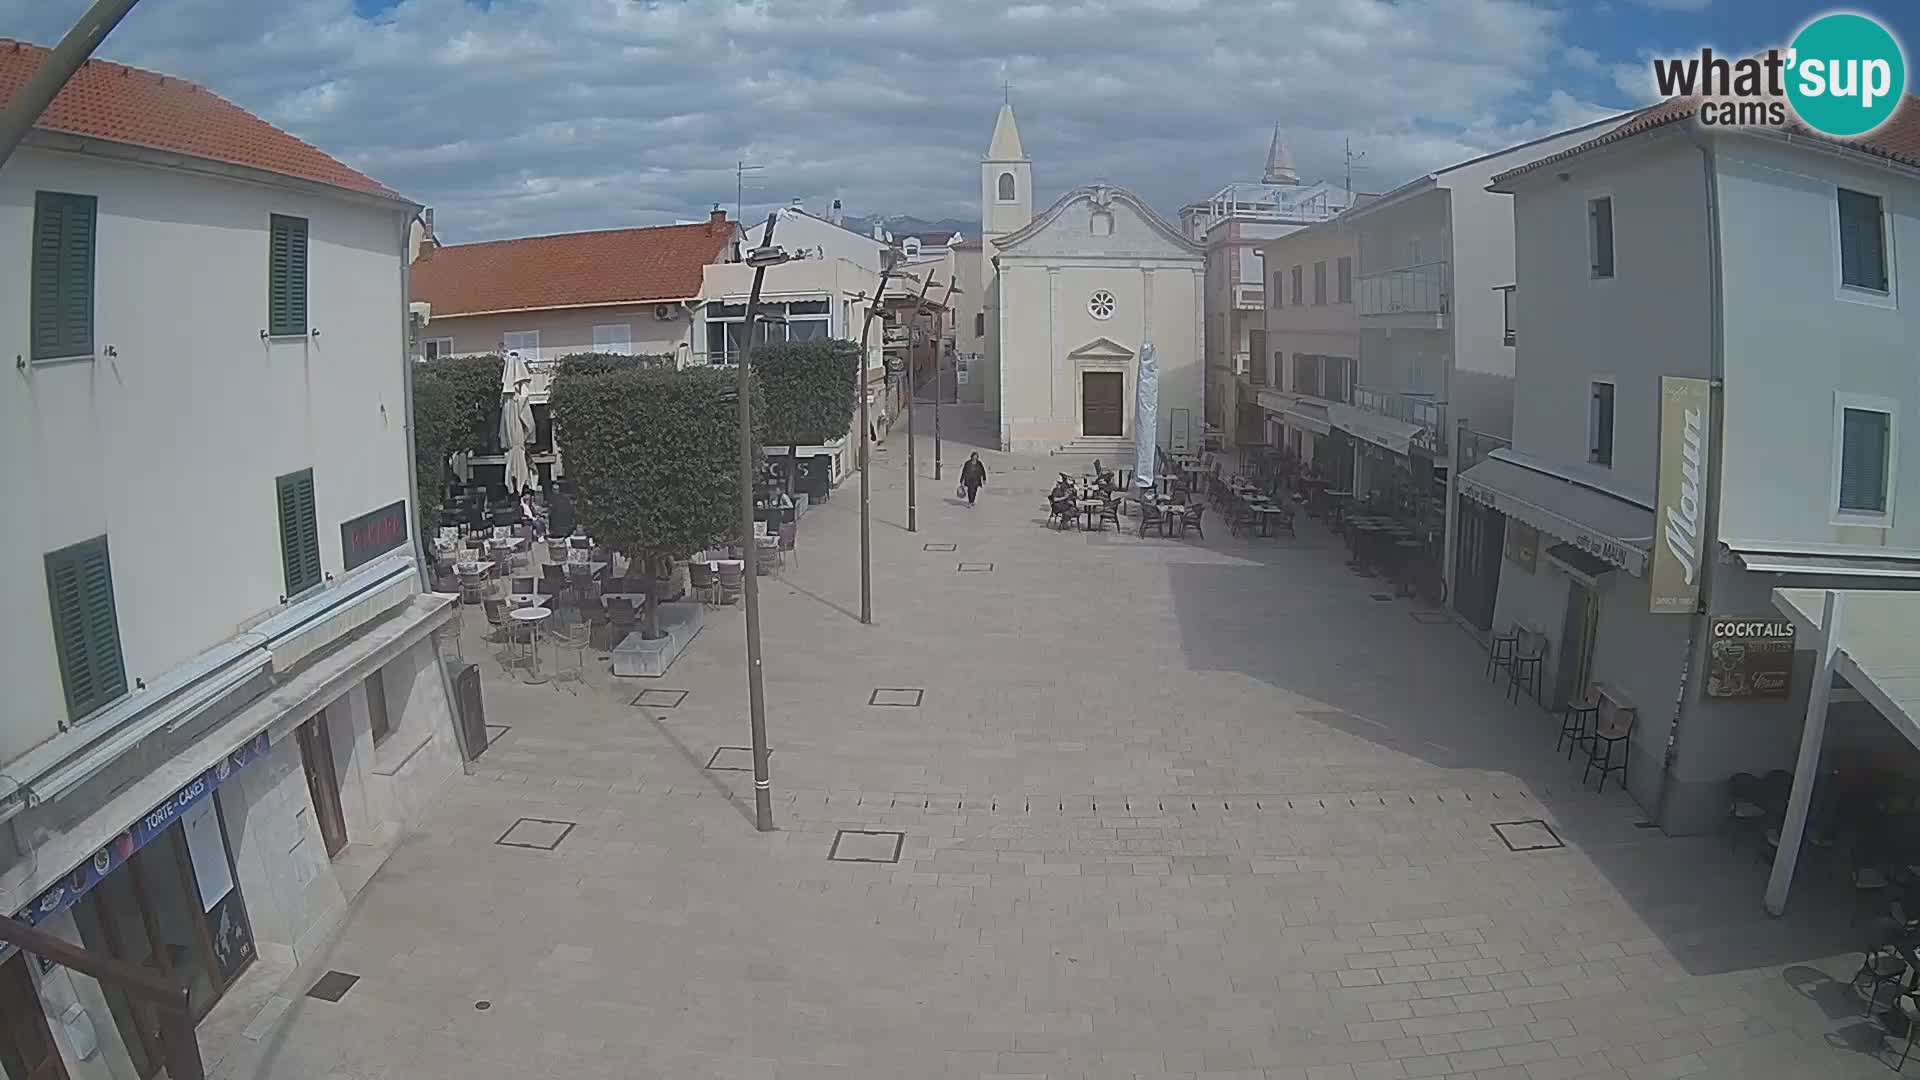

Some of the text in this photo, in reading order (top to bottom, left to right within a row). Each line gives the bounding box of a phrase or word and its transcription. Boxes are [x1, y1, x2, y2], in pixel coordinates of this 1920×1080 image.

[1714, 622, 1795, 638] COCKTAILS
[145, 801, 174, 832] TORTE
[179, 778, 205, 806] CAKES
